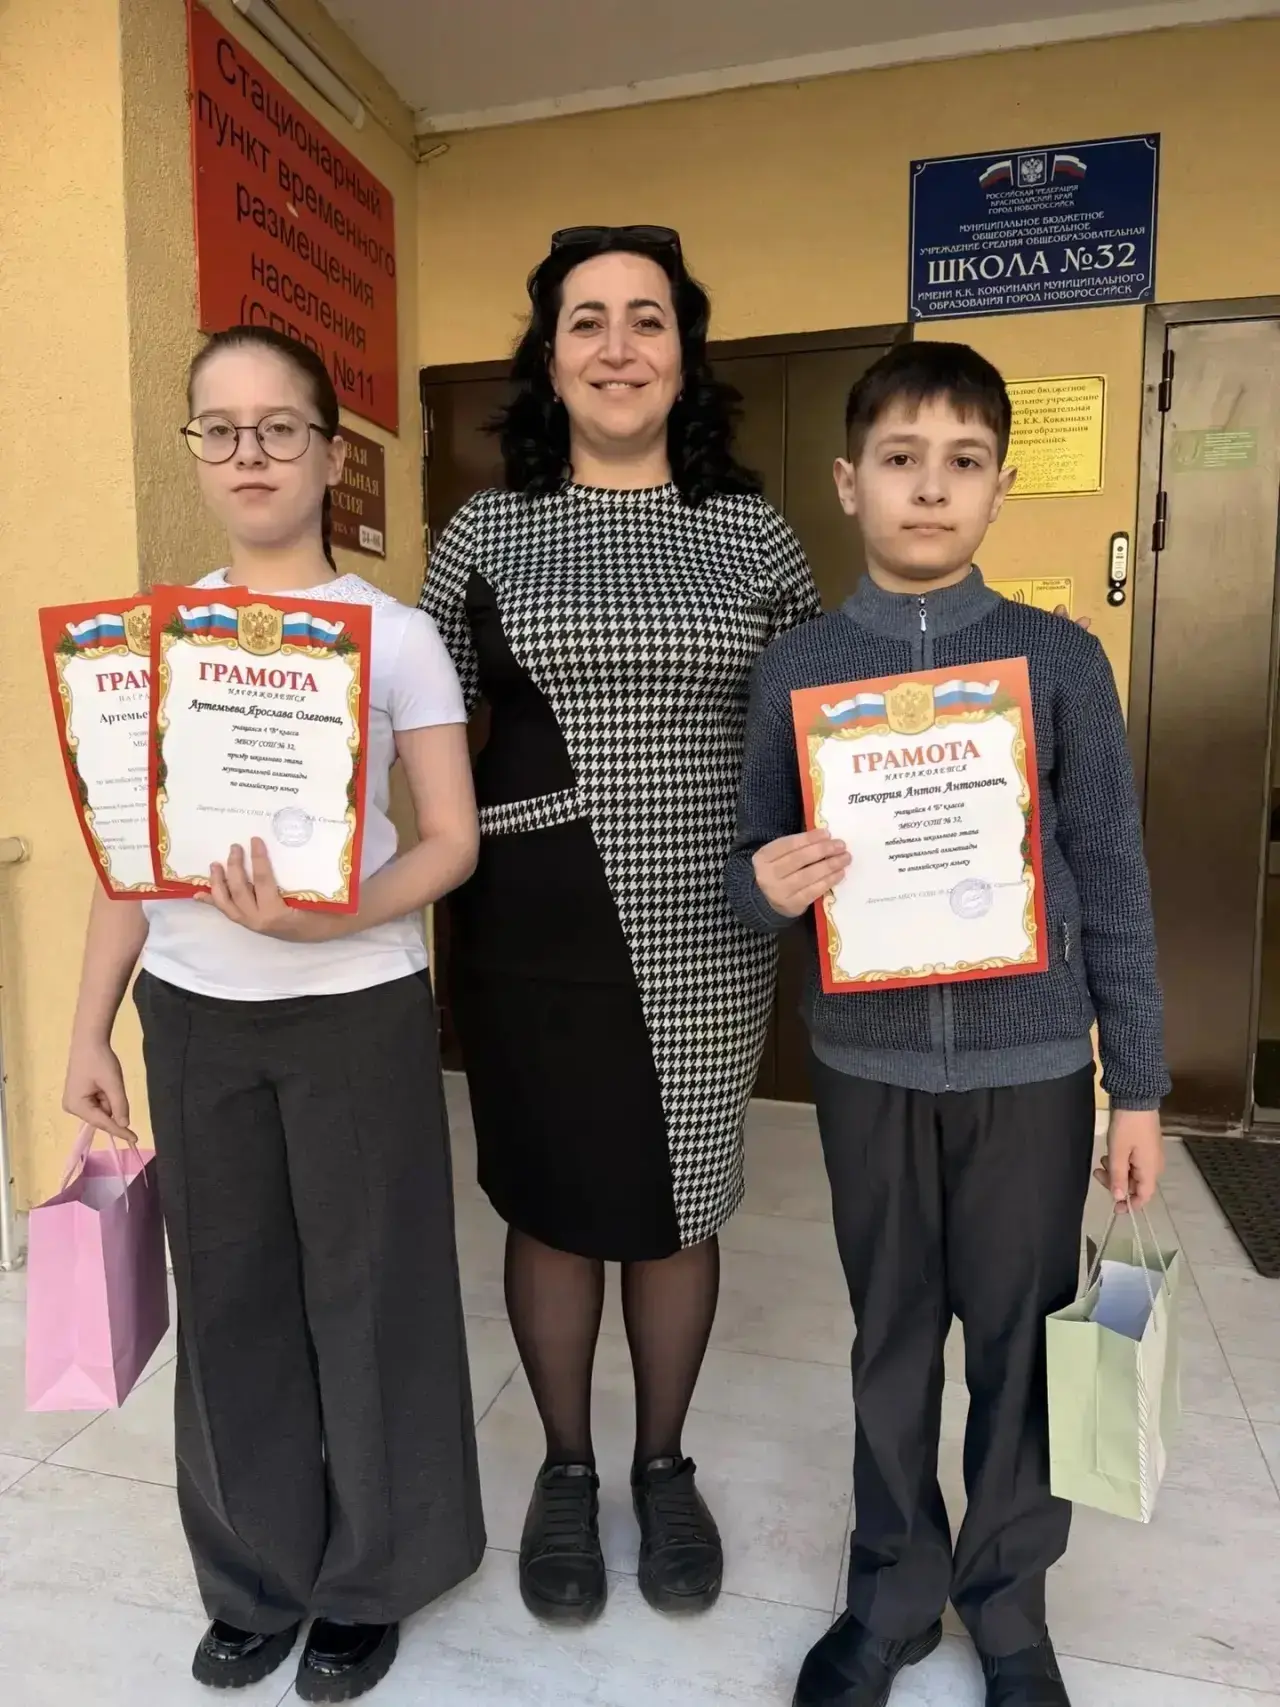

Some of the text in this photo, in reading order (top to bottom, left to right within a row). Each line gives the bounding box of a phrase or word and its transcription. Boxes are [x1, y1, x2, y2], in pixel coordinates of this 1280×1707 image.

[217, 38, 381, 220] Стационарный
[198, 90, 395, 278] пункт временного
[988, 200, 1075, 215] ГОРОД НОВОРОССИЙСК
[991, 192, 1073, 207] КРАСНОДАРСКИЙ КРАЙ
[960, 211, 1105, 233] МУНИЦИПАЛЬНОЕ БЮДЖЕТНОЕ
[237, 183, 374, 309] размещения
[920, 242, 980, 256] УЧРЕЖДЕНИЕ
[982, 238, 1023, 250] СРЕДНЯЯ
[928, 242, 1137, 285] ШКОЛА №32
[918, 273, 1145, 301] ИМЕНИ К.К. КОККИНАКИ МУНИЦИПАЛЬНОГО
[929, 285, 1132, 310] ОБРАЗОВАНИЯ ГОРОД НОВОРОССИЙСК
[251, 252, 366, 353] населения
[333, 352, 374, 406] №11
[199, 661, 319, 692] ГРАМОТА
[99, 710, 150, 726] Артемье
[188, 699, 344, 725] Артемьева Ярослава Олеговна,
[851, 739, 981, 774] ГРАМОТА
[848, 776, 1008, 805] Пачкория Антон Антонович,
